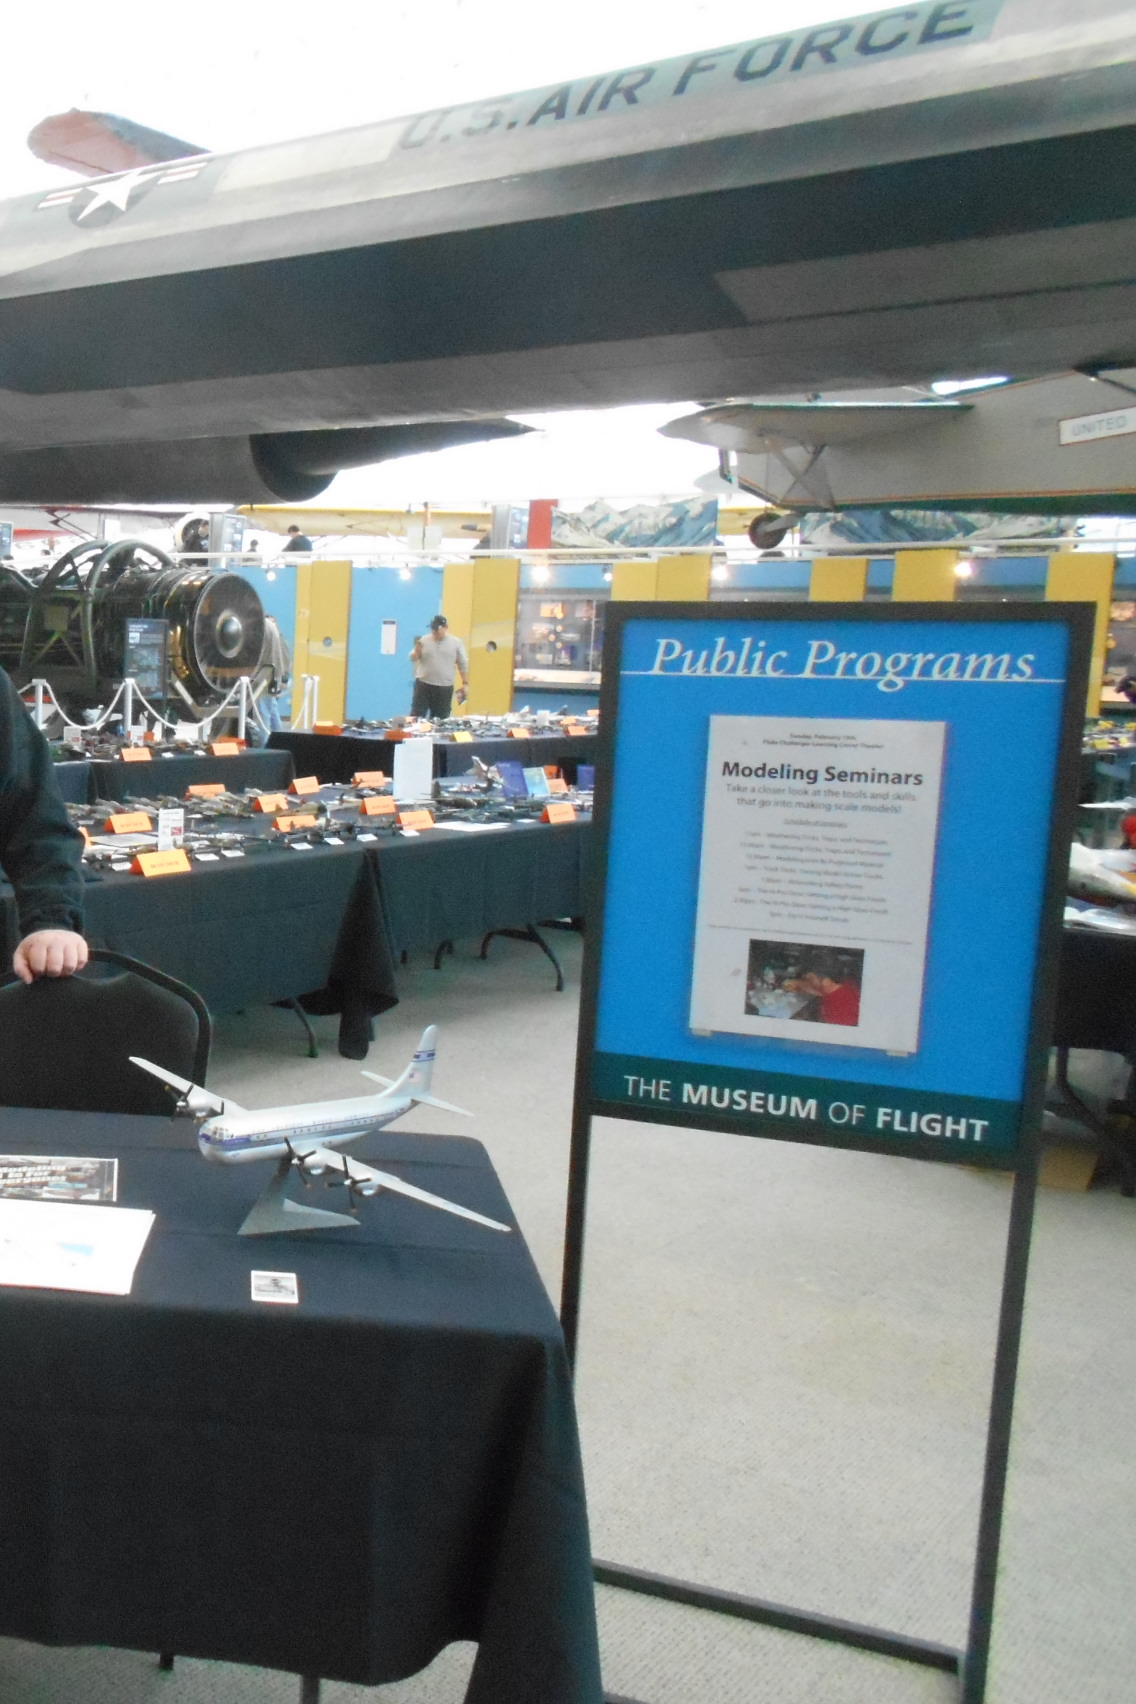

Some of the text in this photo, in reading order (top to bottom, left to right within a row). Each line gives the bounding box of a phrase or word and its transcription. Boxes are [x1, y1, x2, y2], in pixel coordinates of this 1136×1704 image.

[672, 0, 976, 96] FORCE
[1071, 415, 1128, 436] UNITED
[650, 637, 1035, 693] Public Programs
[722, 761, 924, 786] Modeling Seminars
[726, 783, 748, 793] Take
[757, 785, 785, 795] closer
[788, 786, 809, 796] look
[811, 788, 822, 796] at
[824, 788, 841, 798] the
[842, 789, 868, 799] tools
[869, 791, 890, 801] and
[736, 797, 757, 806] that
[758, 799, 772, 808] go
[773, 799, 793, 808] into
[795, 800, 832, 812] making
[834, 802, 859, 812] scale
[623, 1075, 989, 1142] THE MUSEUM OF FLIGHT
